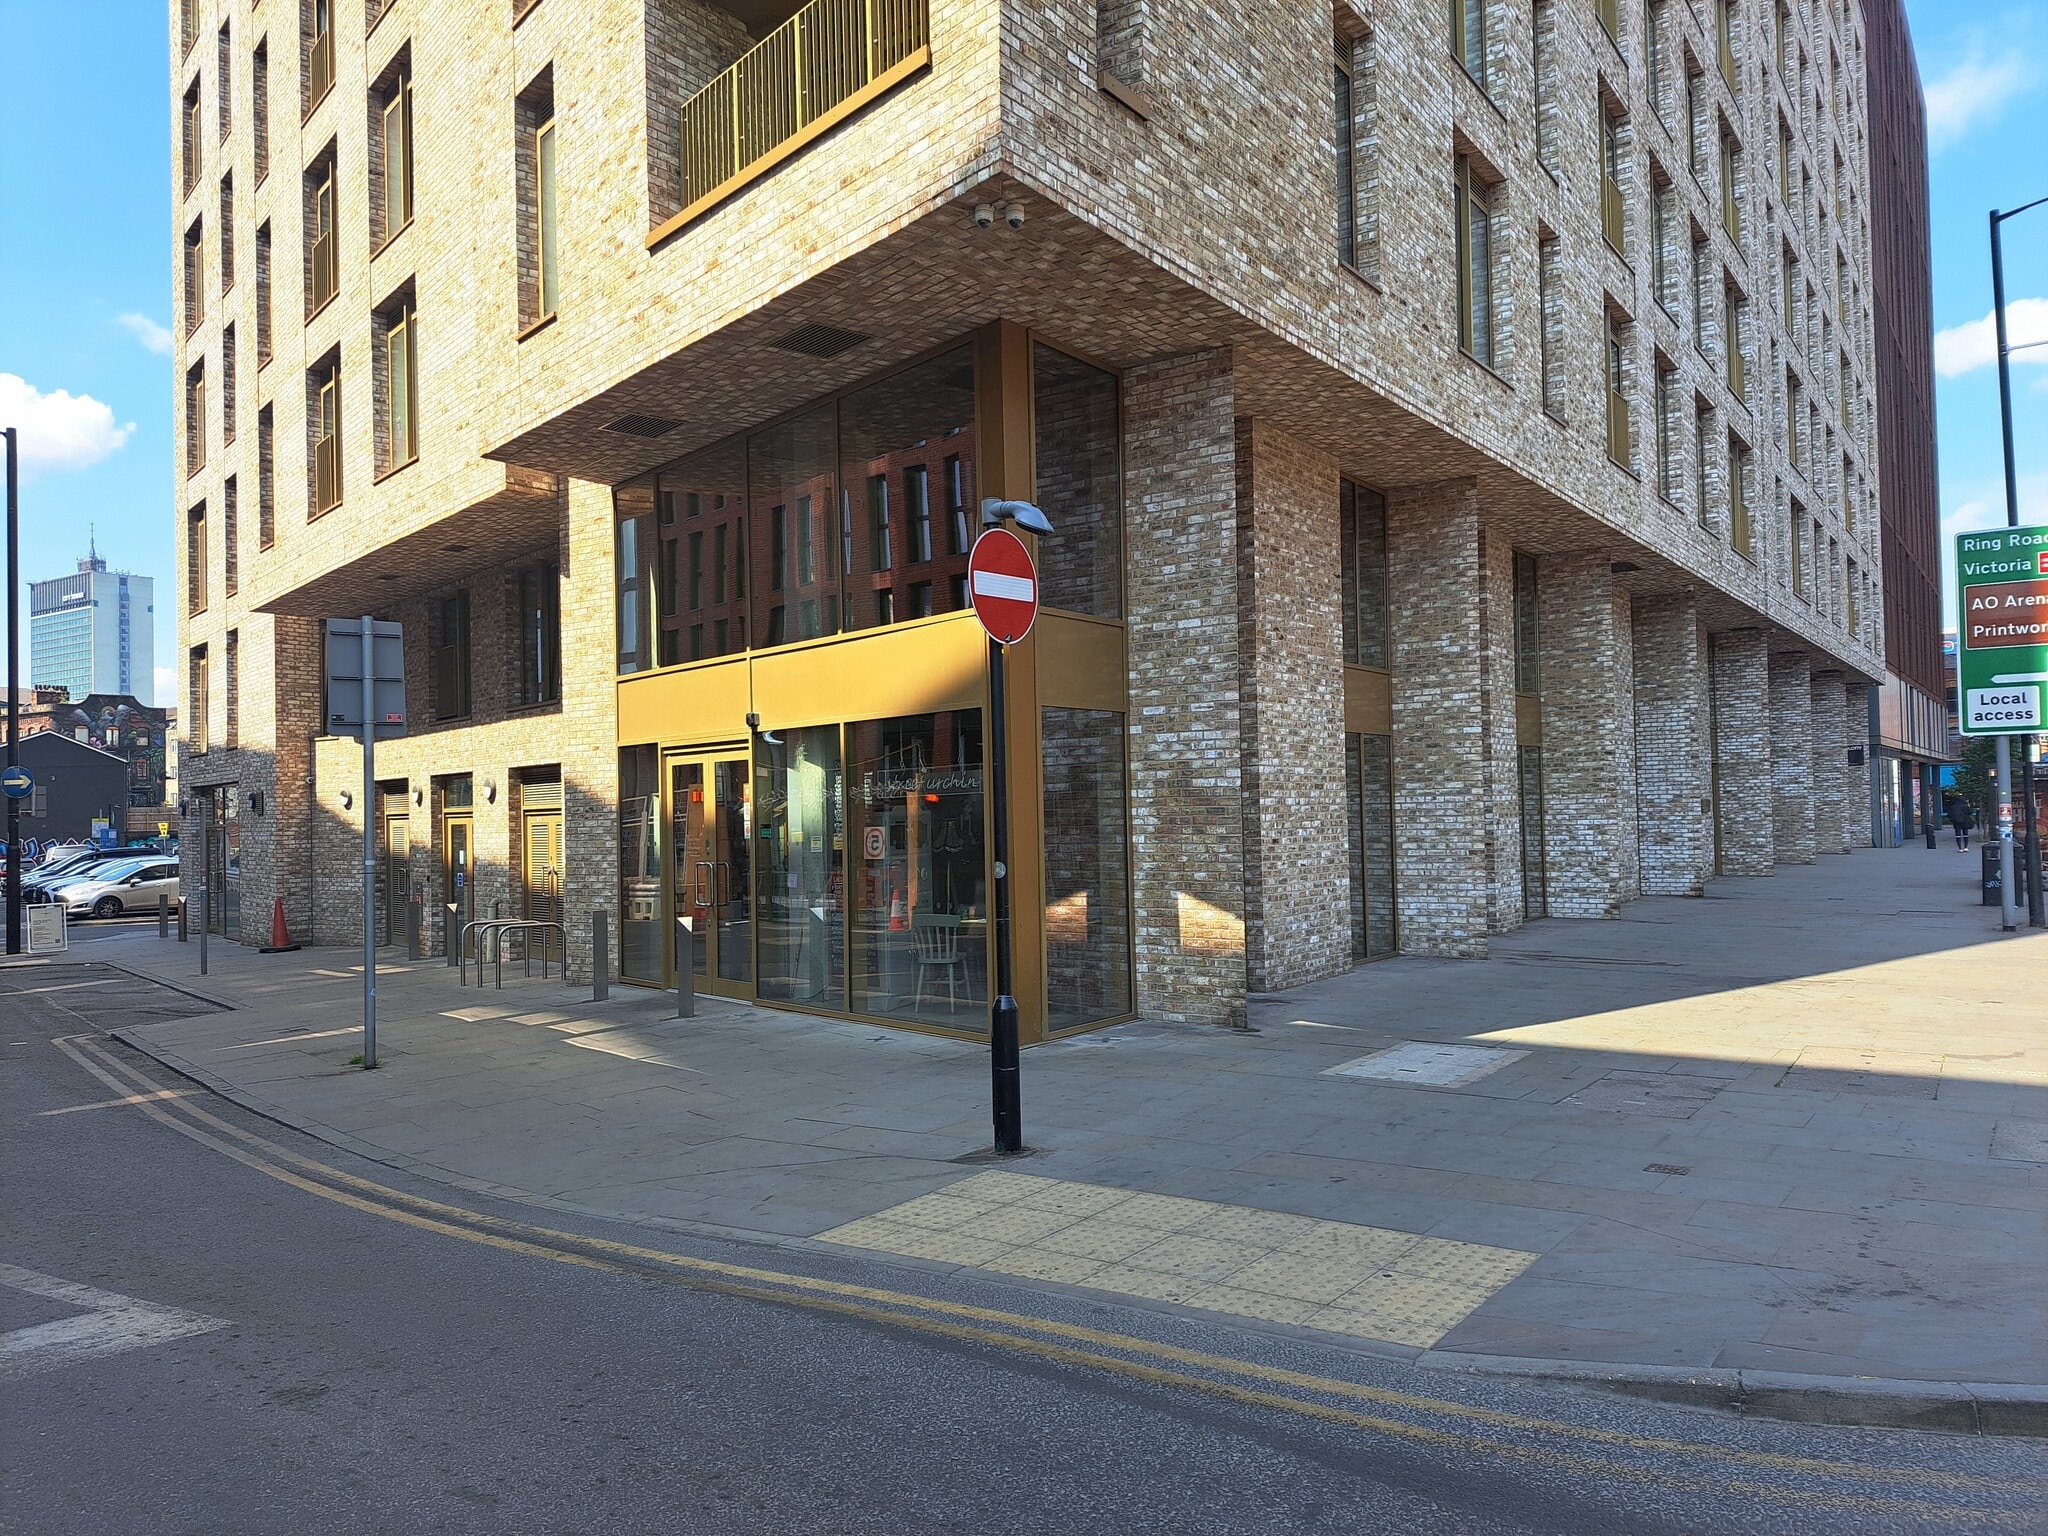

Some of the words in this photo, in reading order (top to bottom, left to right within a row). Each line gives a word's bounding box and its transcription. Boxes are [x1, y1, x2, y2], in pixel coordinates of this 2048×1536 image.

[1964, 538, 2001, 552] Ring
[1963, 558, 2032, 576] Victoria
[1971, 596, 1999, 610] AO
[1980, 691, 2027, 706] Local
[1974, 708, 2034, 722] access
[926, 771, 980, 789] urchin
